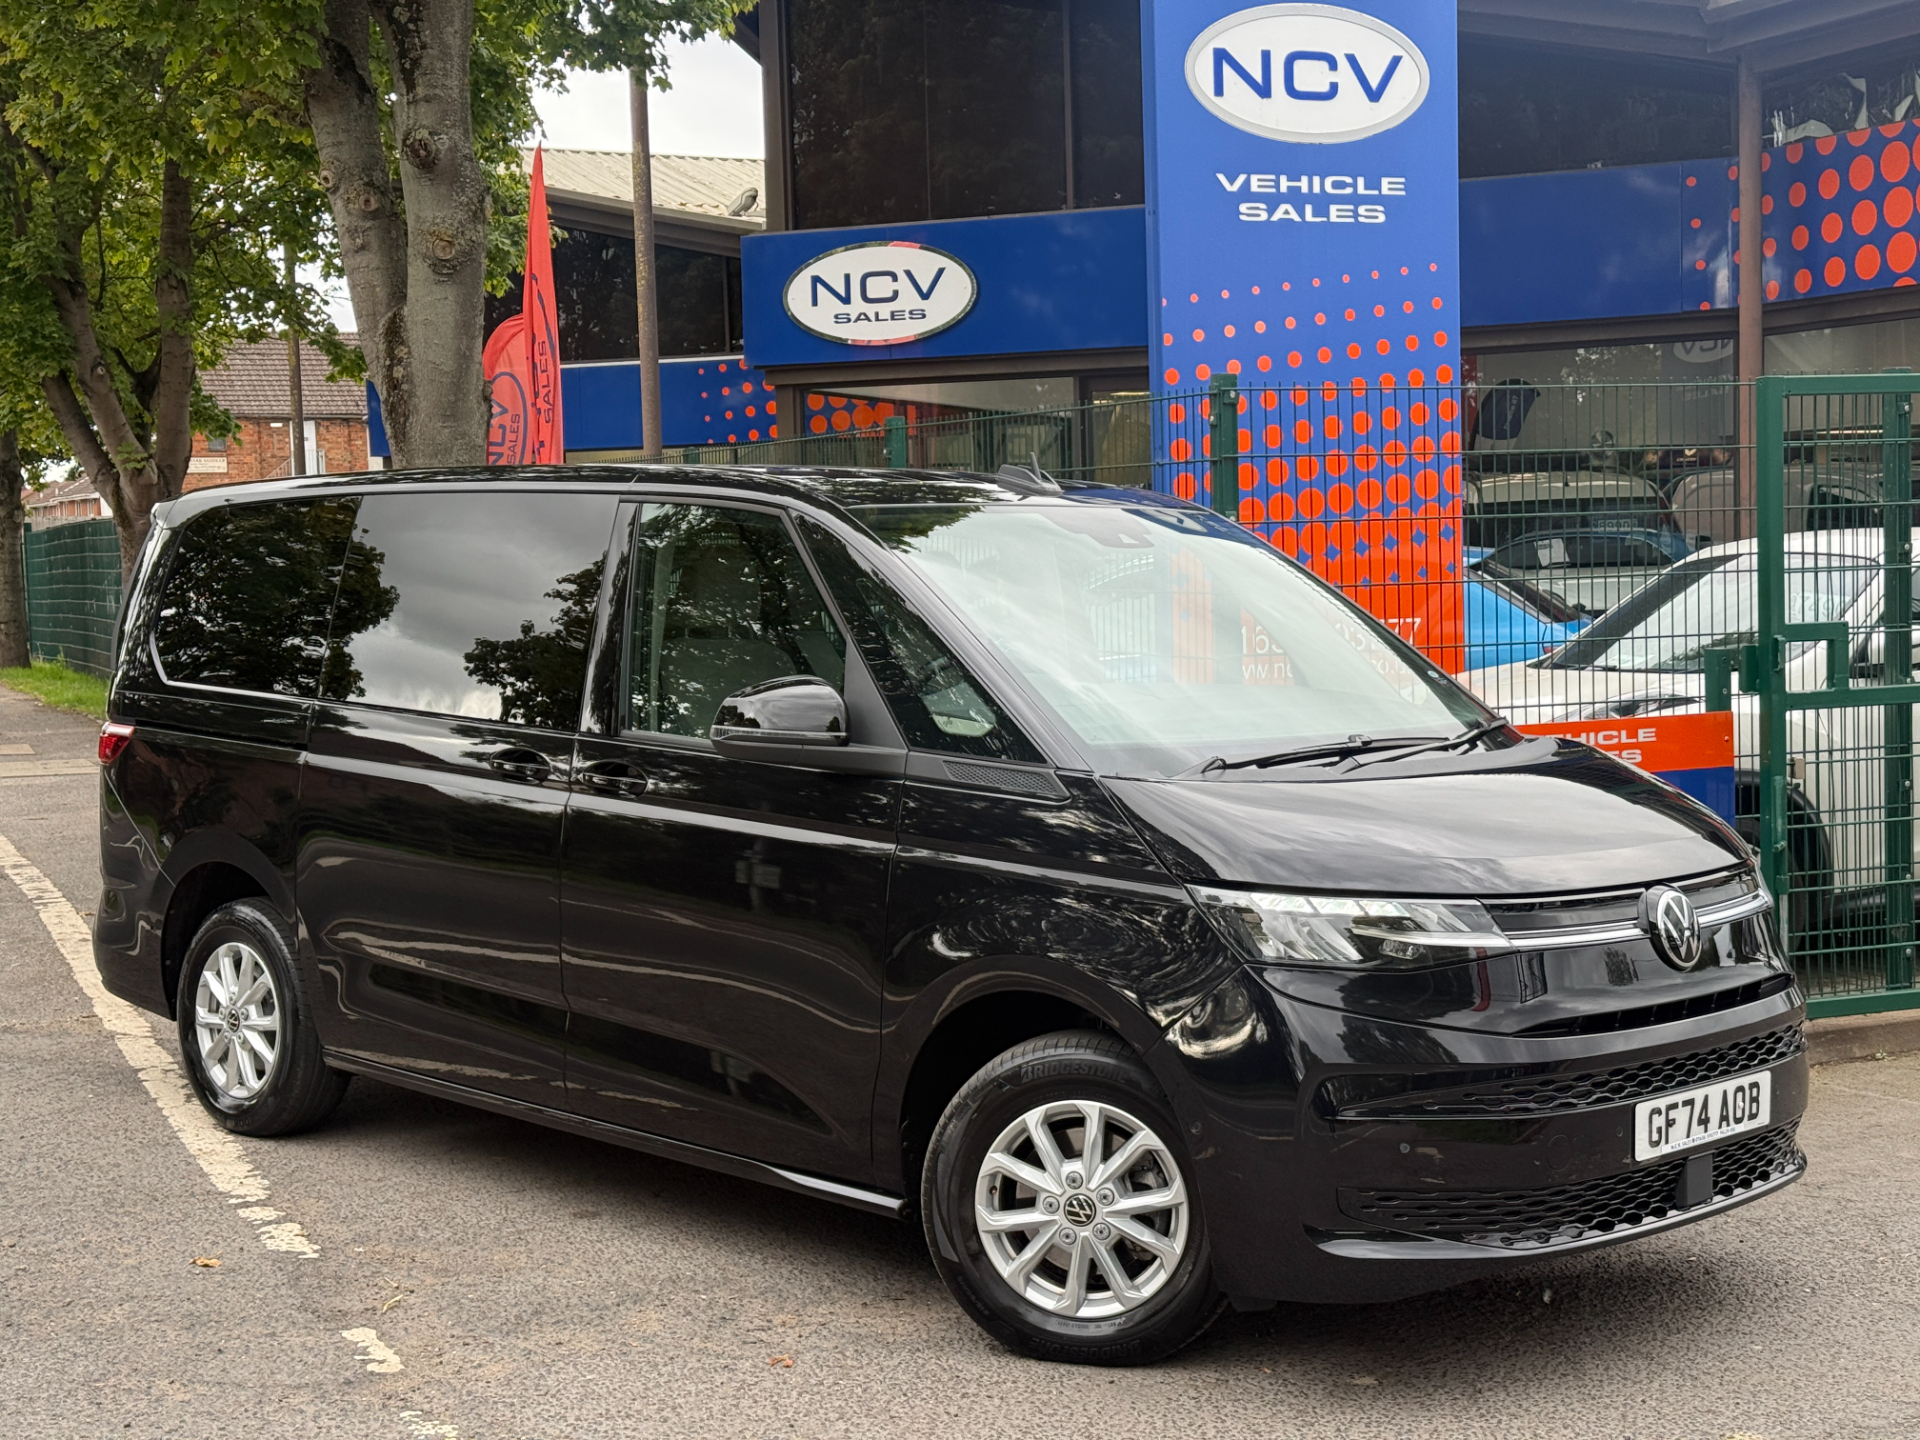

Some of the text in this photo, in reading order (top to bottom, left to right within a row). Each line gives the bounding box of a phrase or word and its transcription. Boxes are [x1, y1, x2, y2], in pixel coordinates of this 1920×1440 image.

[1212, 47, 1404, 103] NCV
[1215, 173, 1406, 195] VEHICLE
[1238, 203, 1387, 223] SALES
[810, 267, 946, 307] NCV
[833, 308, 927, 324] SALES
[538, 340, 554, 424] SALES
[507, 413, 520, 465] SALES
[1648, 1093, 1711, 1148] GF74
[1718, 1081, 1761, 1130] AOB
